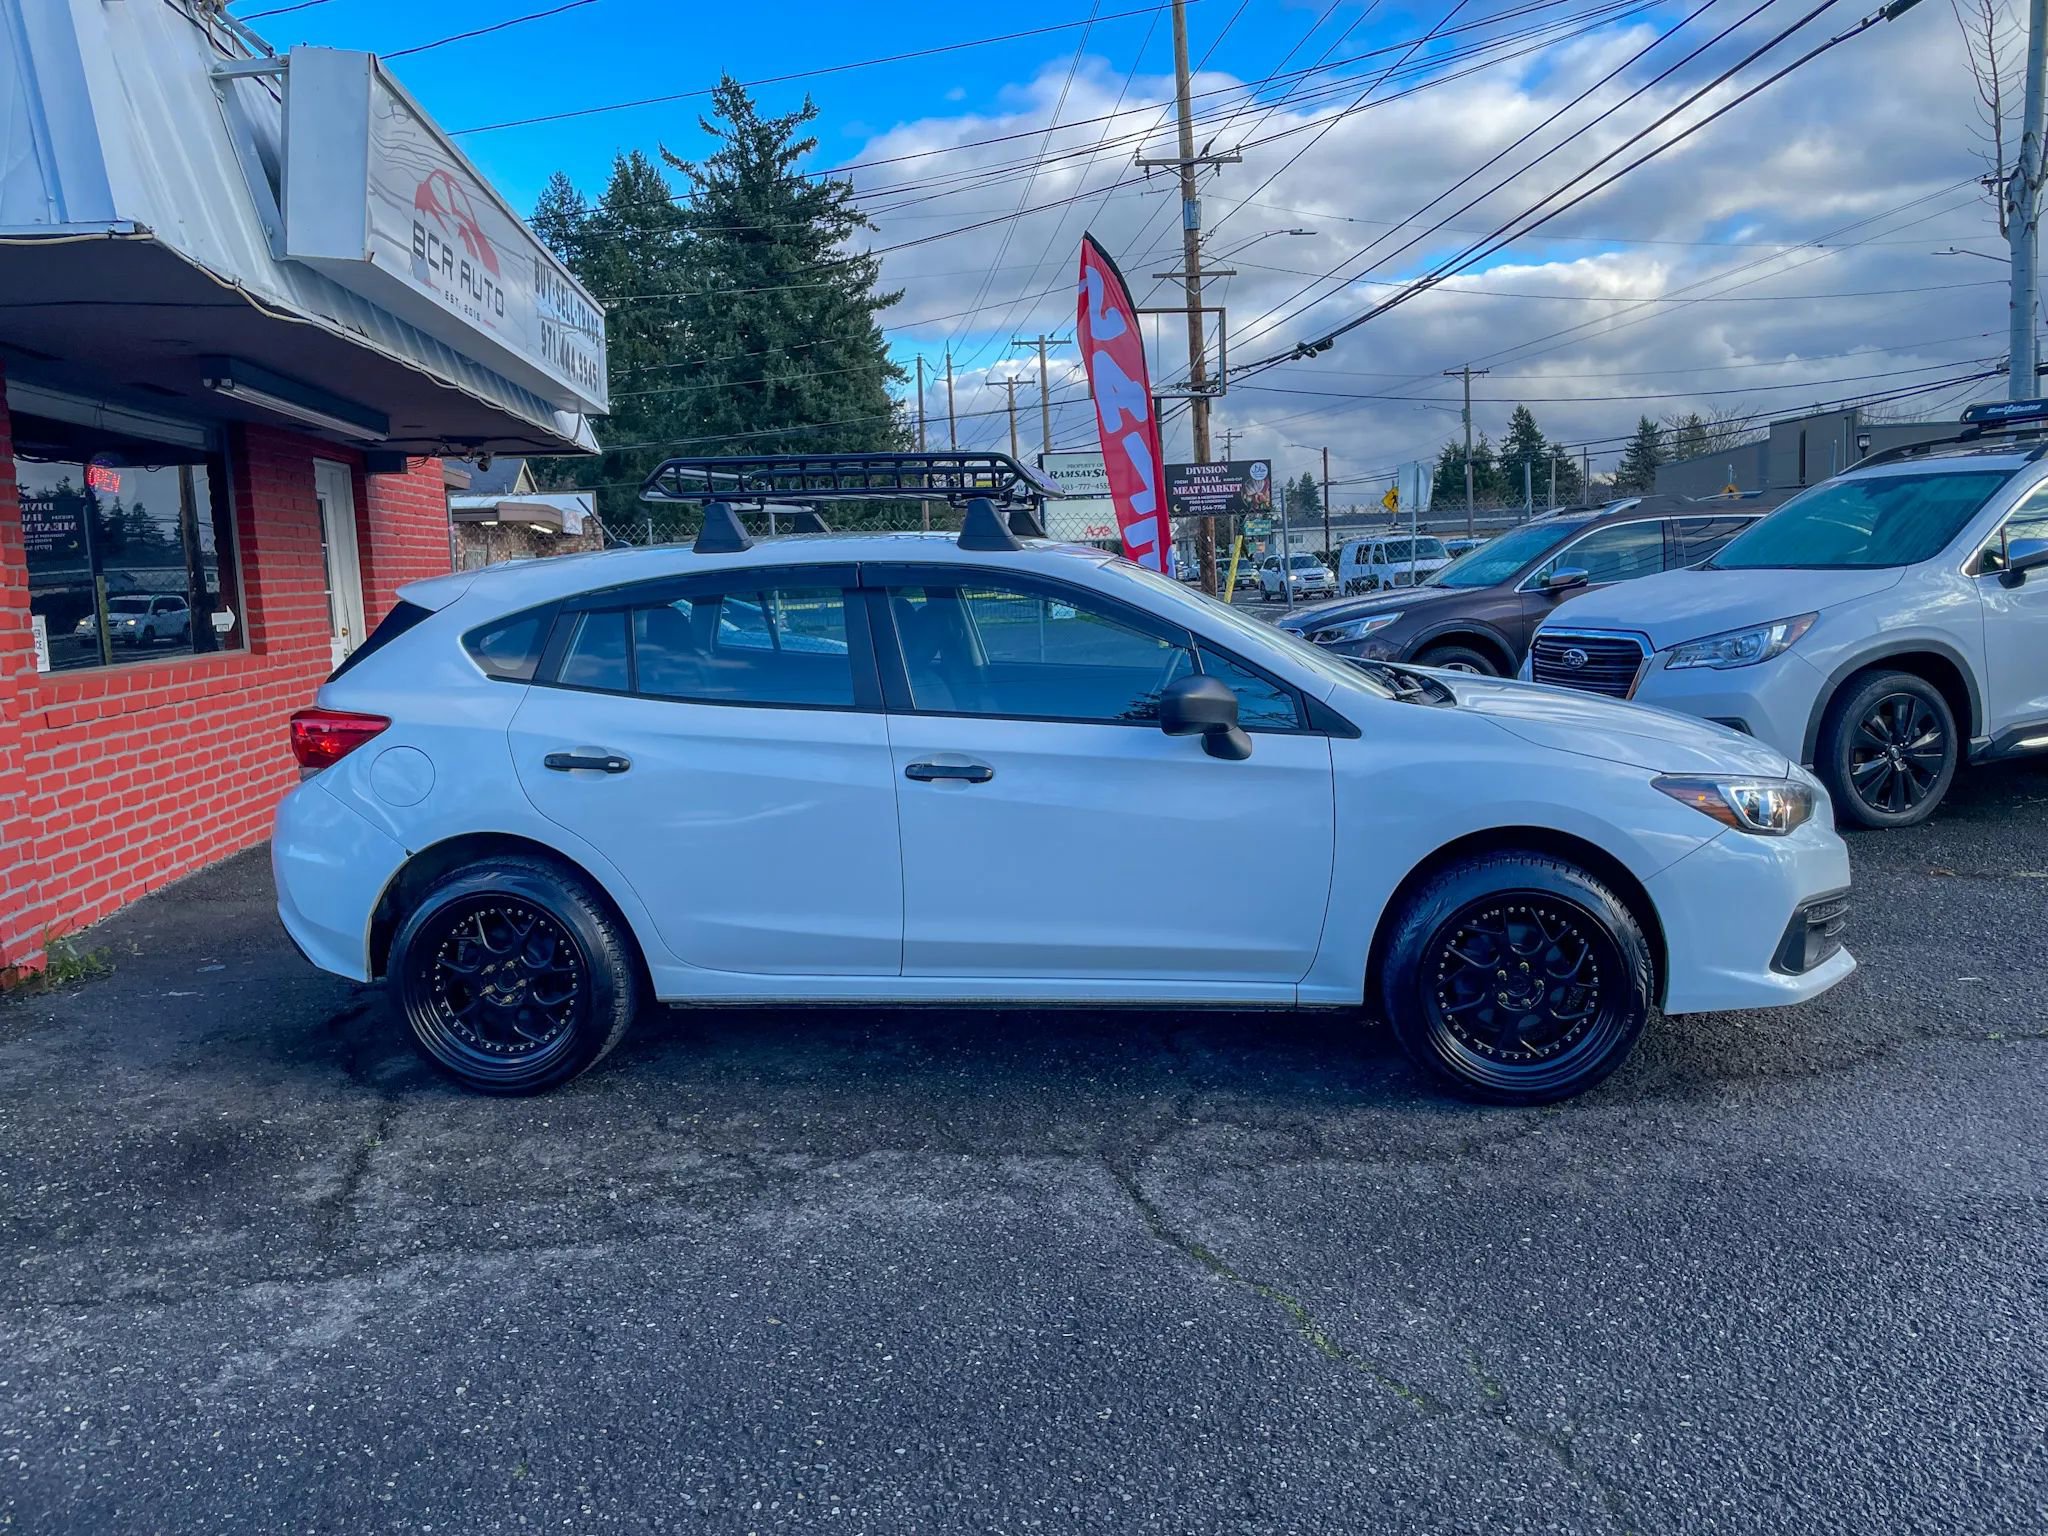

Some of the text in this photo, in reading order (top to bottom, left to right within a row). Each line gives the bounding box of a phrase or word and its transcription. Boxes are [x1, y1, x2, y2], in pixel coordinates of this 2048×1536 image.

[413, 219, 504, 318] BCR AUTO
[1185, 465, 1228, 475] DIVISION
[88, 467, 120, 493] OPEN
[1193, 476, 1221, 484] HALAL
[1172, 483, 1242, 495] MEAT MARKET
